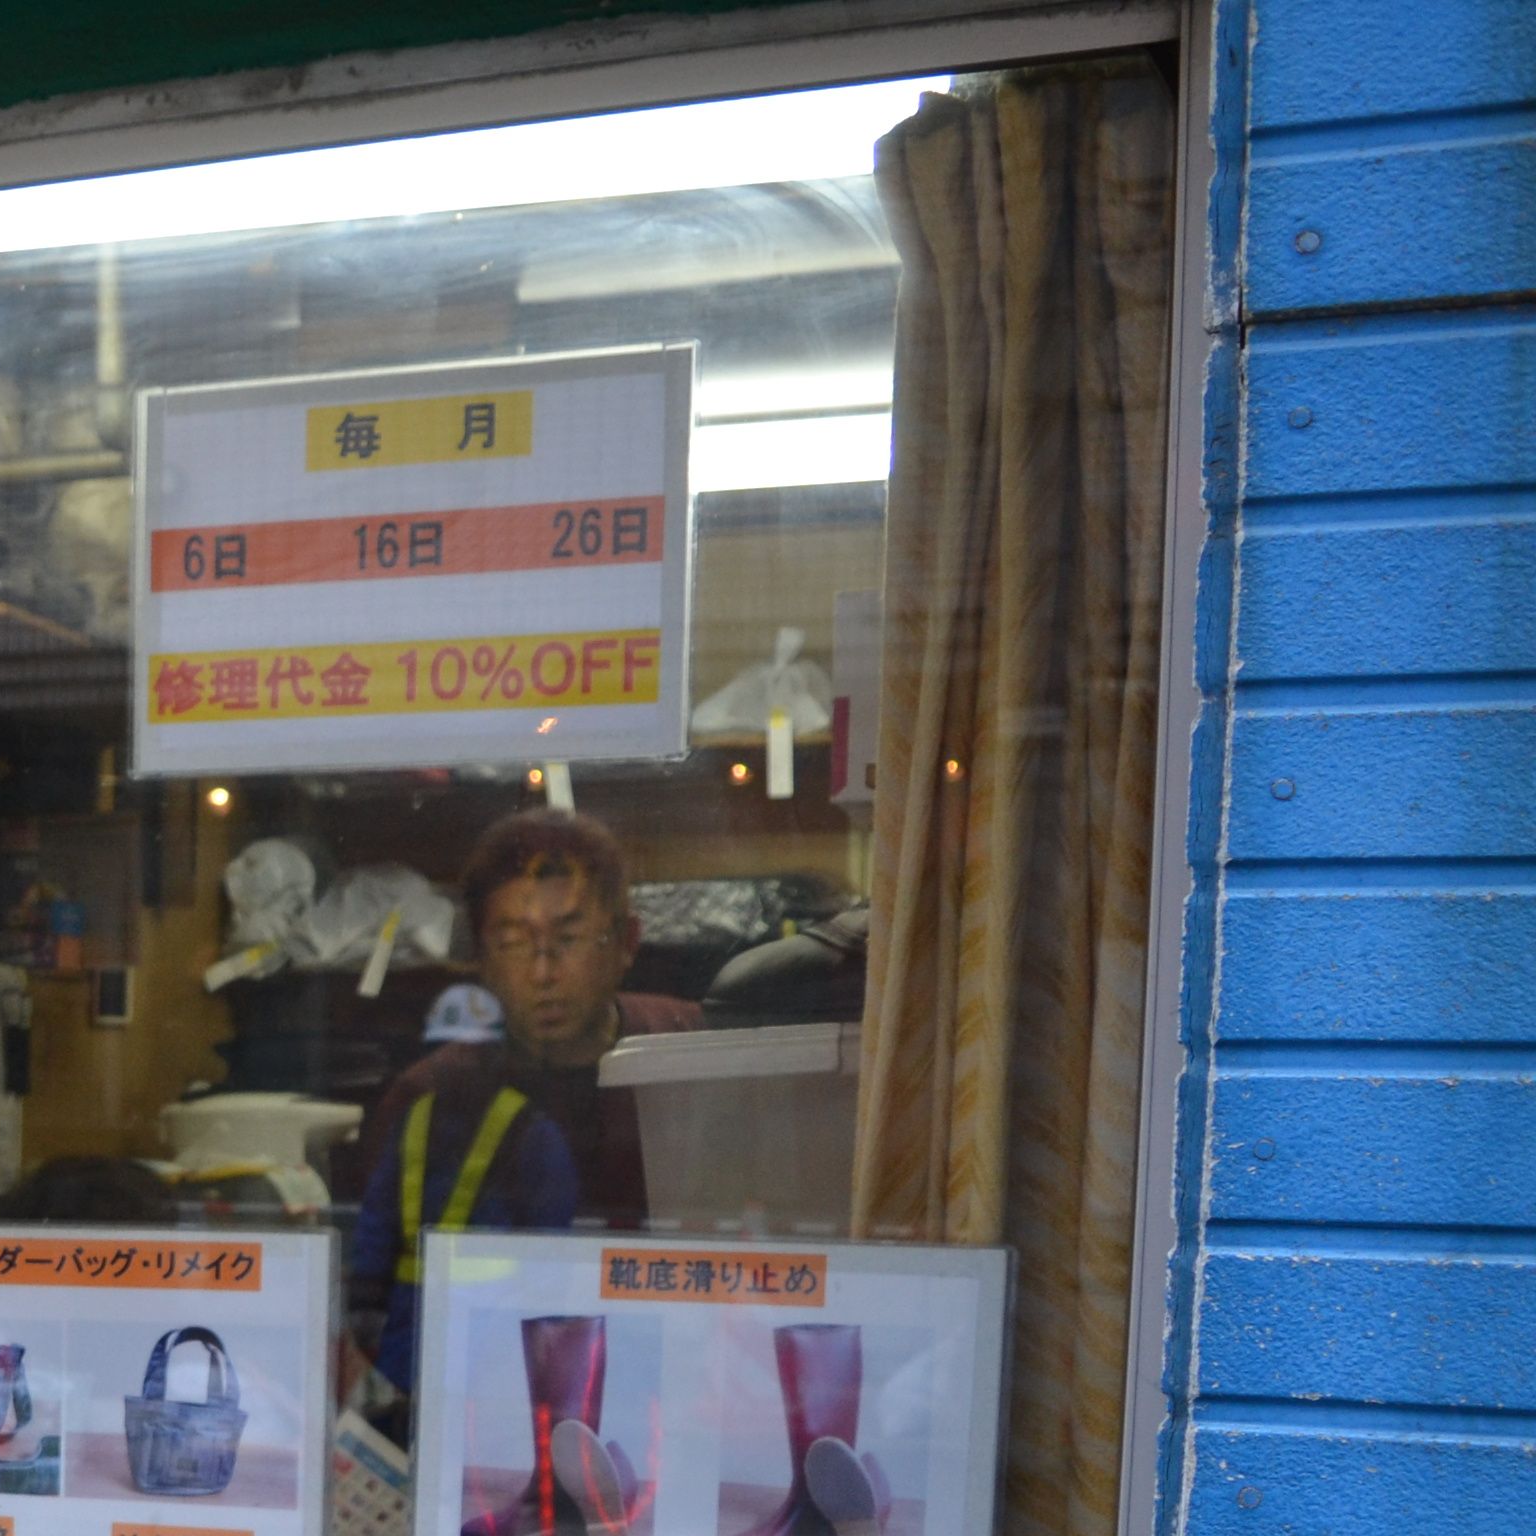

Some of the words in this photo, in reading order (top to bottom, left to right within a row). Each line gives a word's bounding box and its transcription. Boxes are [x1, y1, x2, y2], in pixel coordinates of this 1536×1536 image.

[182, 533, 248, 581] 6日
[352, 520, 444, 572] 16日
[550, 507, 649, 560] 26日
[153, 652, 373, 716] 修理代金
[397, 636, 660, 703] 10%OFF
[608, 1257, 818, 1297] 靴底滑り止め
